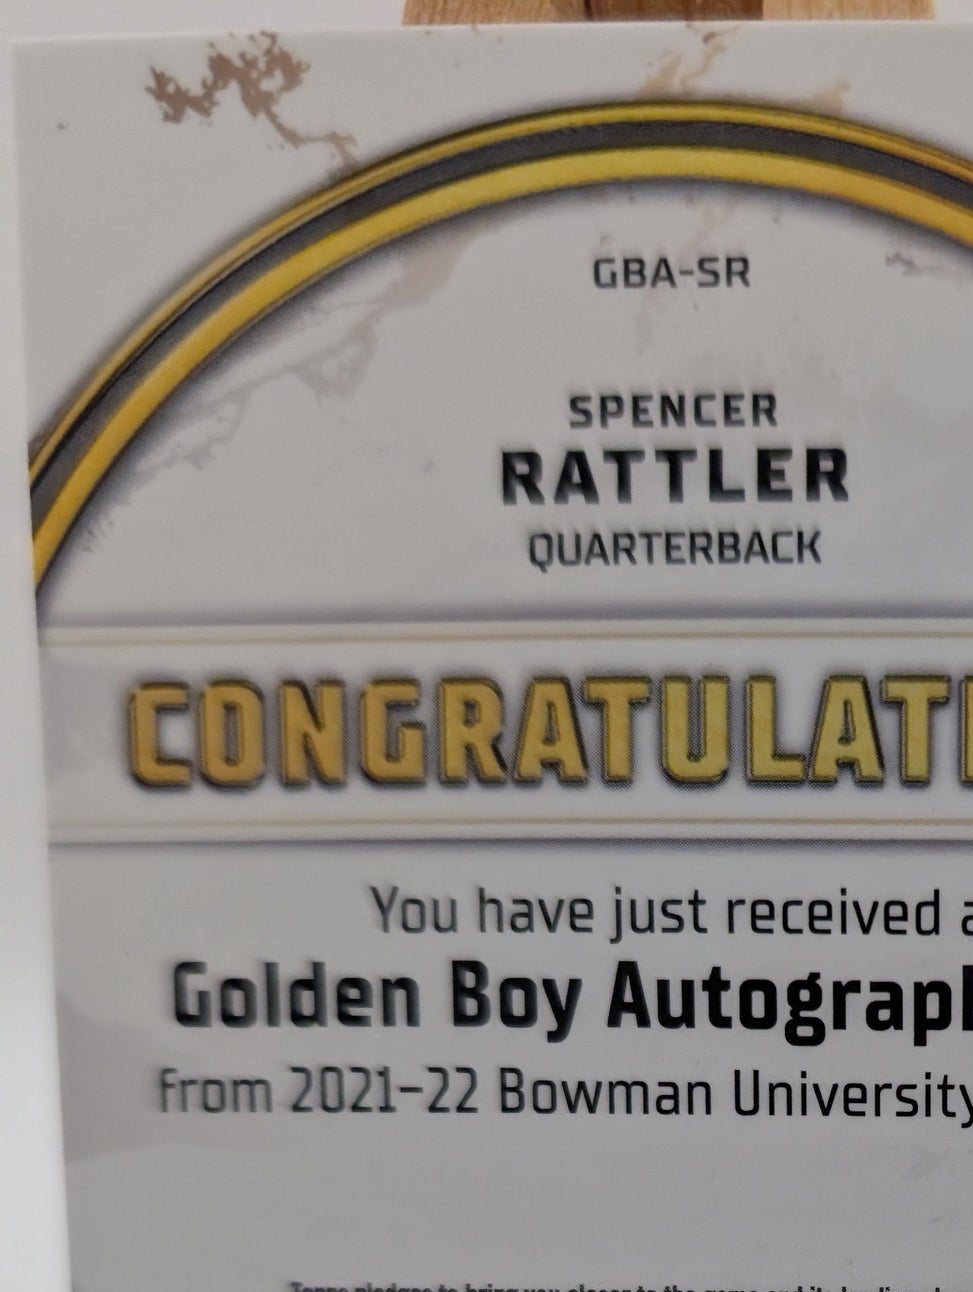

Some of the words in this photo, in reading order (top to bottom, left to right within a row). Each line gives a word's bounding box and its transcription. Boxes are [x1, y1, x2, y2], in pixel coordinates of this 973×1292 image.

[592, 254, 751, 289] GBA-SR
[568, 391, 778, 429] SPENCER
[500, 445, 849, 506] RATTLER
[527, 527, 822, 573] QUARTERBACK
[370, 885, 458, 934] You
[478, 886, 594, 934] have
[609, 885, 708, 945] just
[727, 886, 941, 937] received
[171, 959, 421, 1029] Golden
[450, 959, 583, 1044] Boy
[157, 1067, 273, 1114] from
[499, 1066, 712, 1116] Bowman
